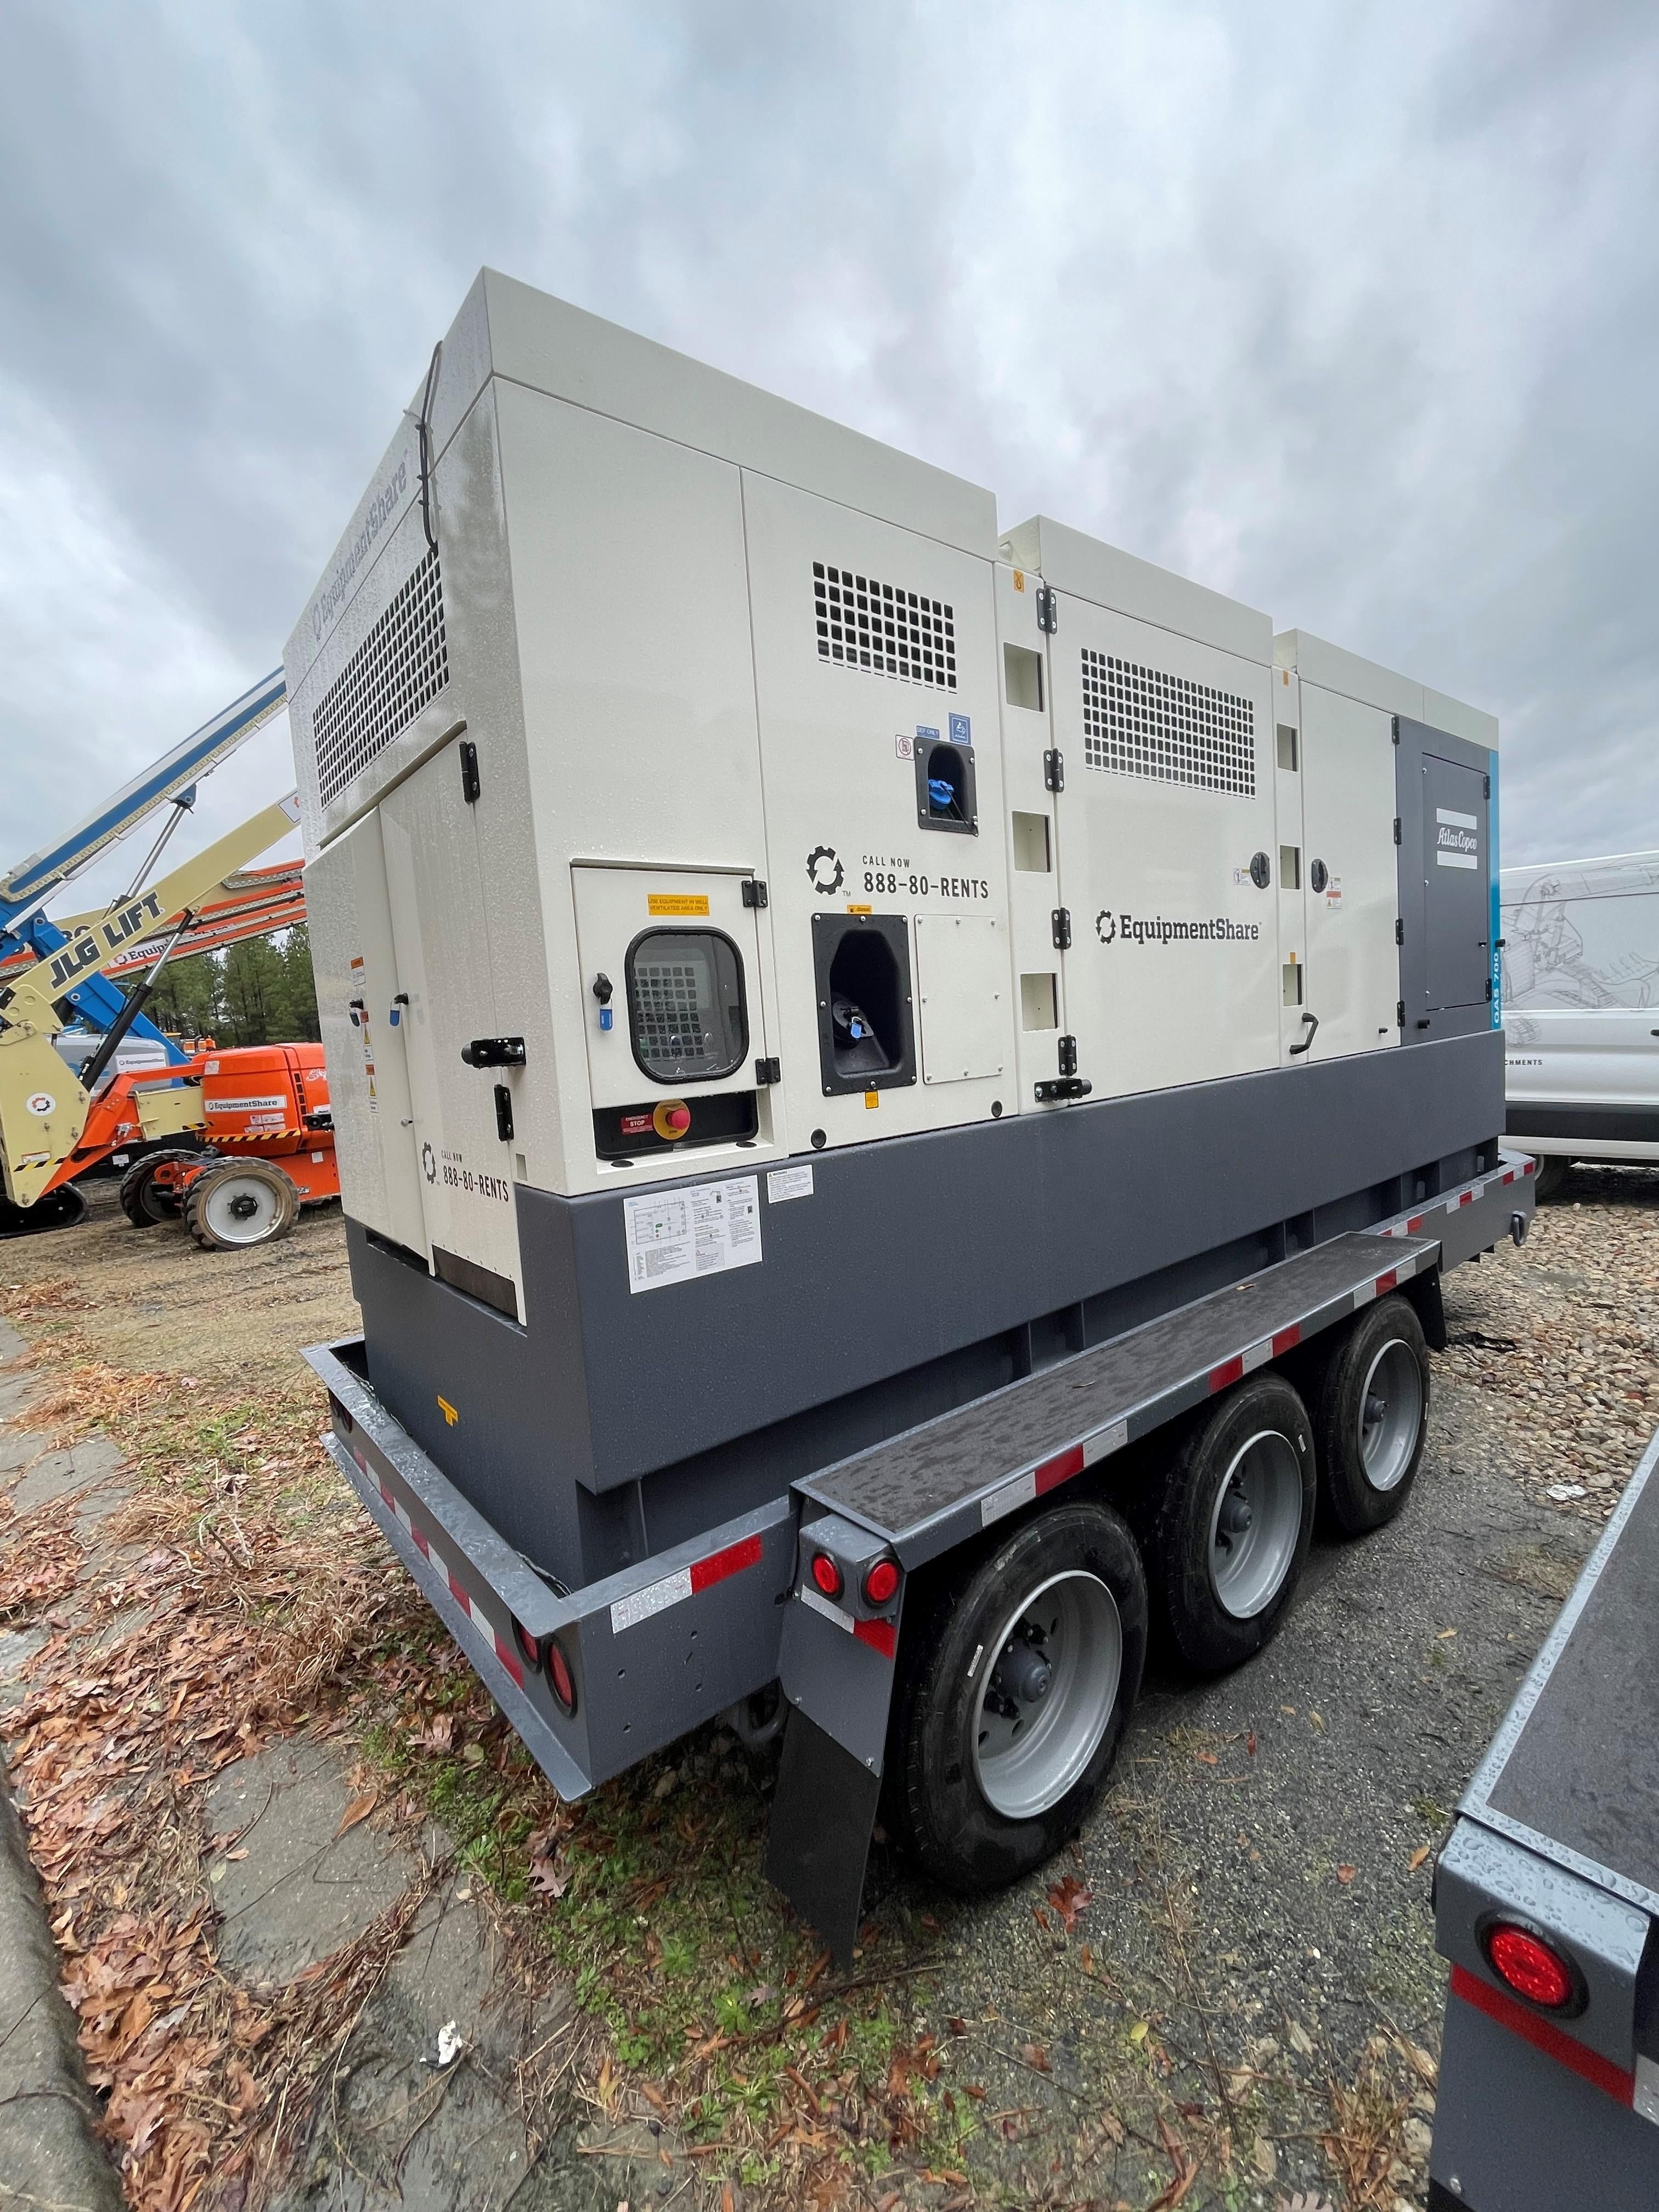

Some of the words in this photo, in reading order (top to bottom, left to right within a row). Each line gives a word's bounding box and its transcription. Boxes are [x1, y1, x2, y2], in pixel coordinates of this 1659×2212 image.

[862, 855, 886, 867] CALL
[890, 857, 910, 868] NOW
[864, 871, 989, 899] 888-80-RENTS
[50, 935, 101, 989] JLG
[103, 891, 161, 949] LIFT
[1120, 915, 1259, 944] EquipmentShare
[215, 1100, 278, 1110] EquipmentShare
[441, 1150, 452, 1160] CALL
[453, 1153, 462, 1163] NOW
[443, 1165, 509, 1202] 888-80-RENTS
